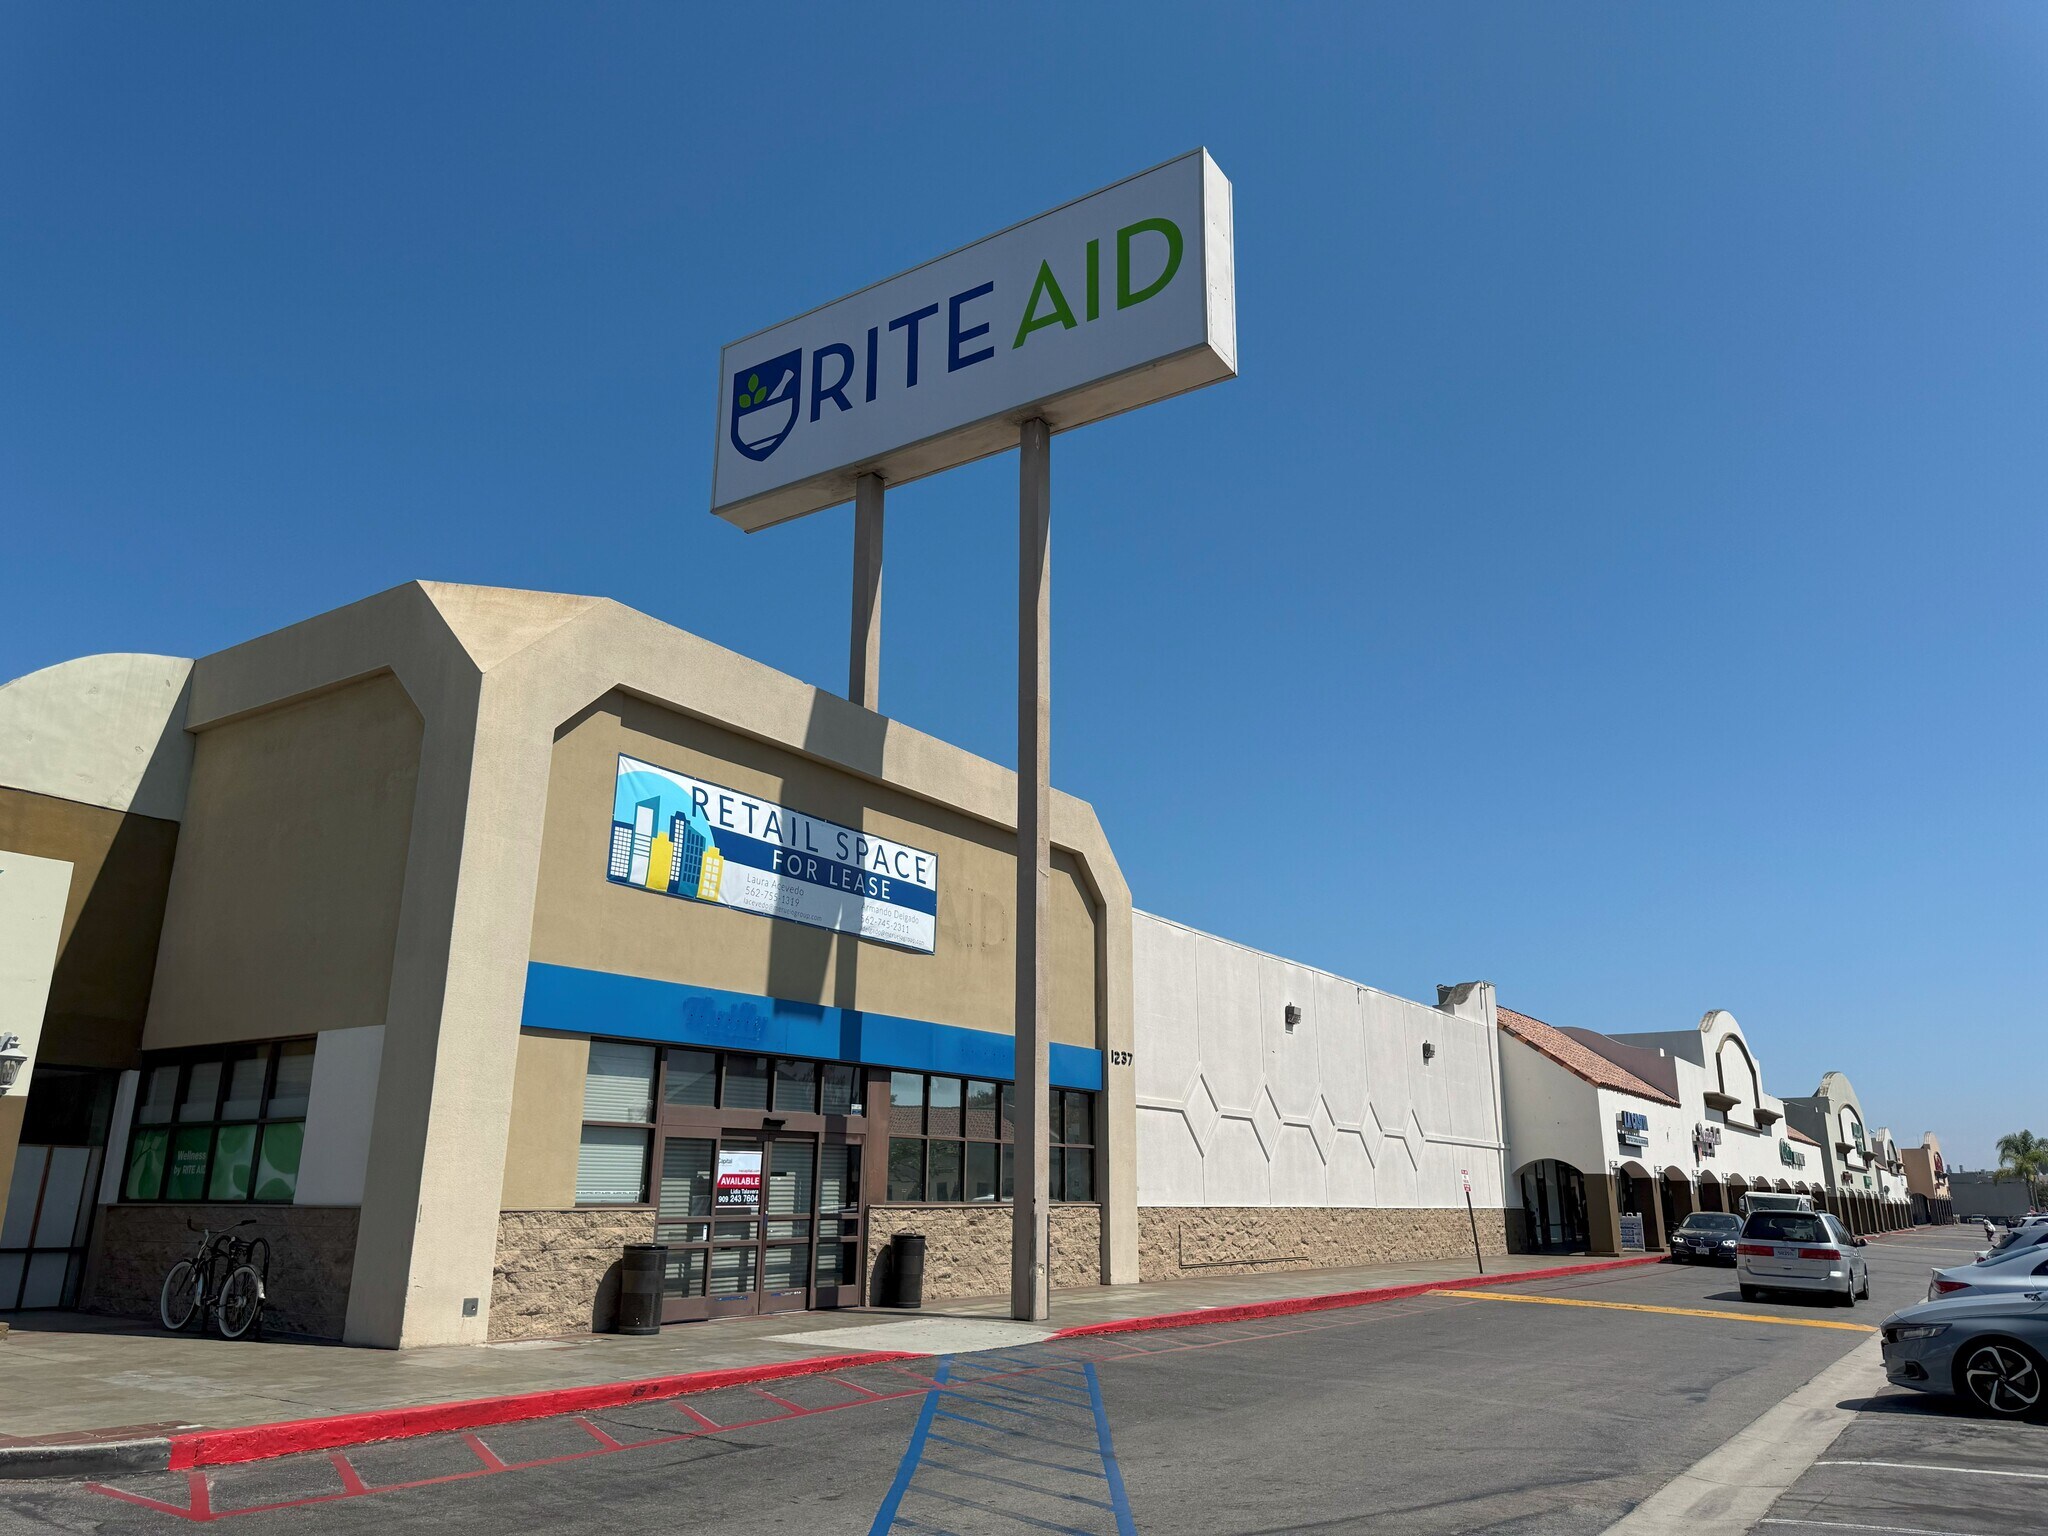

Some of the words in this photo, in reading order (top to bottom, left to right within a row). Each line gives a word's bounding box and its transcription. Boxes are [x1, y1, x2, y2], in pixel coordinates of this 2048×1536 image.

[810, 281, 994, 423] RITE
[1012, 217, 1184, 350] AID
[692, 786, 819, 853] RETAIL
[836, 831, 927, 884] SPACE
[772, 849, 817, 880] FOR
[829, 865, 891, 899] LEASE
[747, 873, 769, 887] Laura
[771, 880, 804, 896] Acevedo
[745, 886, 800, 907] 562-755-1319
[893, 909, 920, 925] Delgado
[1111, 1050, 1133, 1067] 1237
[177, 1150, 207, 1160] Wellness
[173, 1165, 182, 1177] by
[182, 1165, 196, 1175] RITE
[720, 1177, 760, 1185] AVAILABLE
[718, 1195, 729, 1203] 909
[730, 1194, 742, 1203] 243
[743, 1194, 759, 1203] 7604
